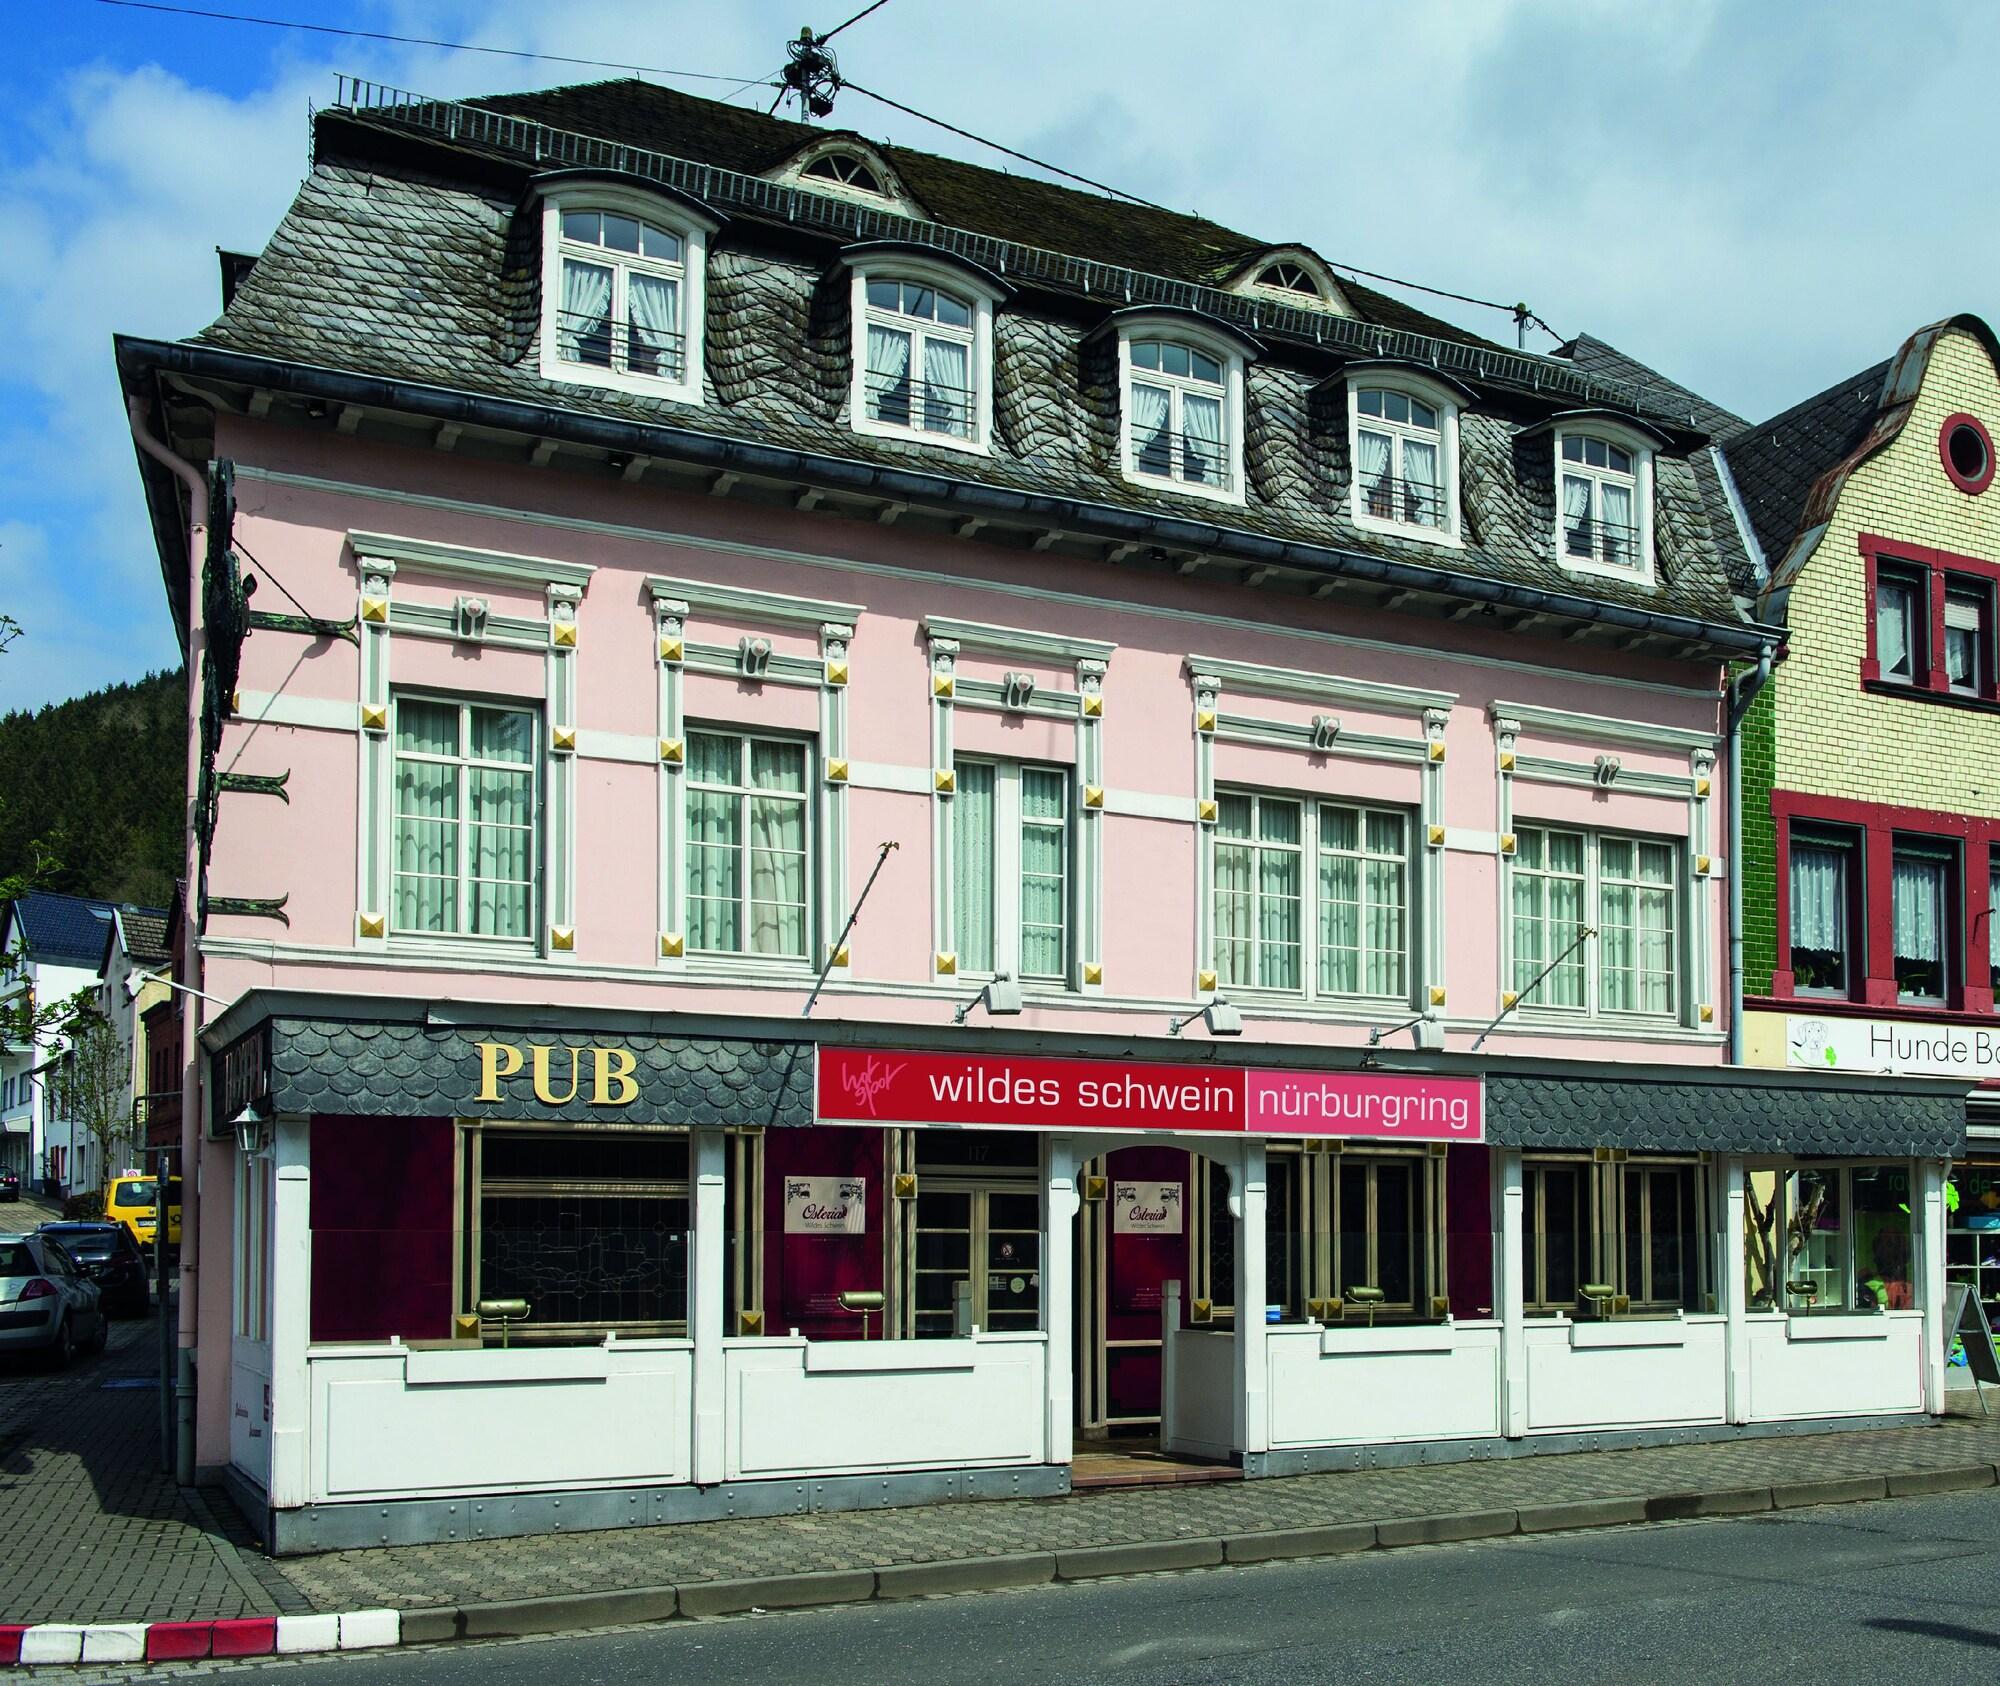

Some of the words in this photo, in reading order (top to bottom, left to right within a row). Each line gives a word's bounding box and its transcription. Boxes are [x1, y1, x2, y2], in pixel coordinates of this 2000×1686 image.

[1870, 1024, 1968, 1064] Hunde
[1976, 1031, 2000, 1064] B
[474, 1043, 640, 1105] PUB
[928, 1066, 1061, 1106] wildes
[1078, 1073, 1234, 1113] schwein
[1259, 1083, 1469, 1130] nürburgring
[802, 1203, 845, 1220] Osteria
[1129, 1205, 1166, 1221] Osteria
